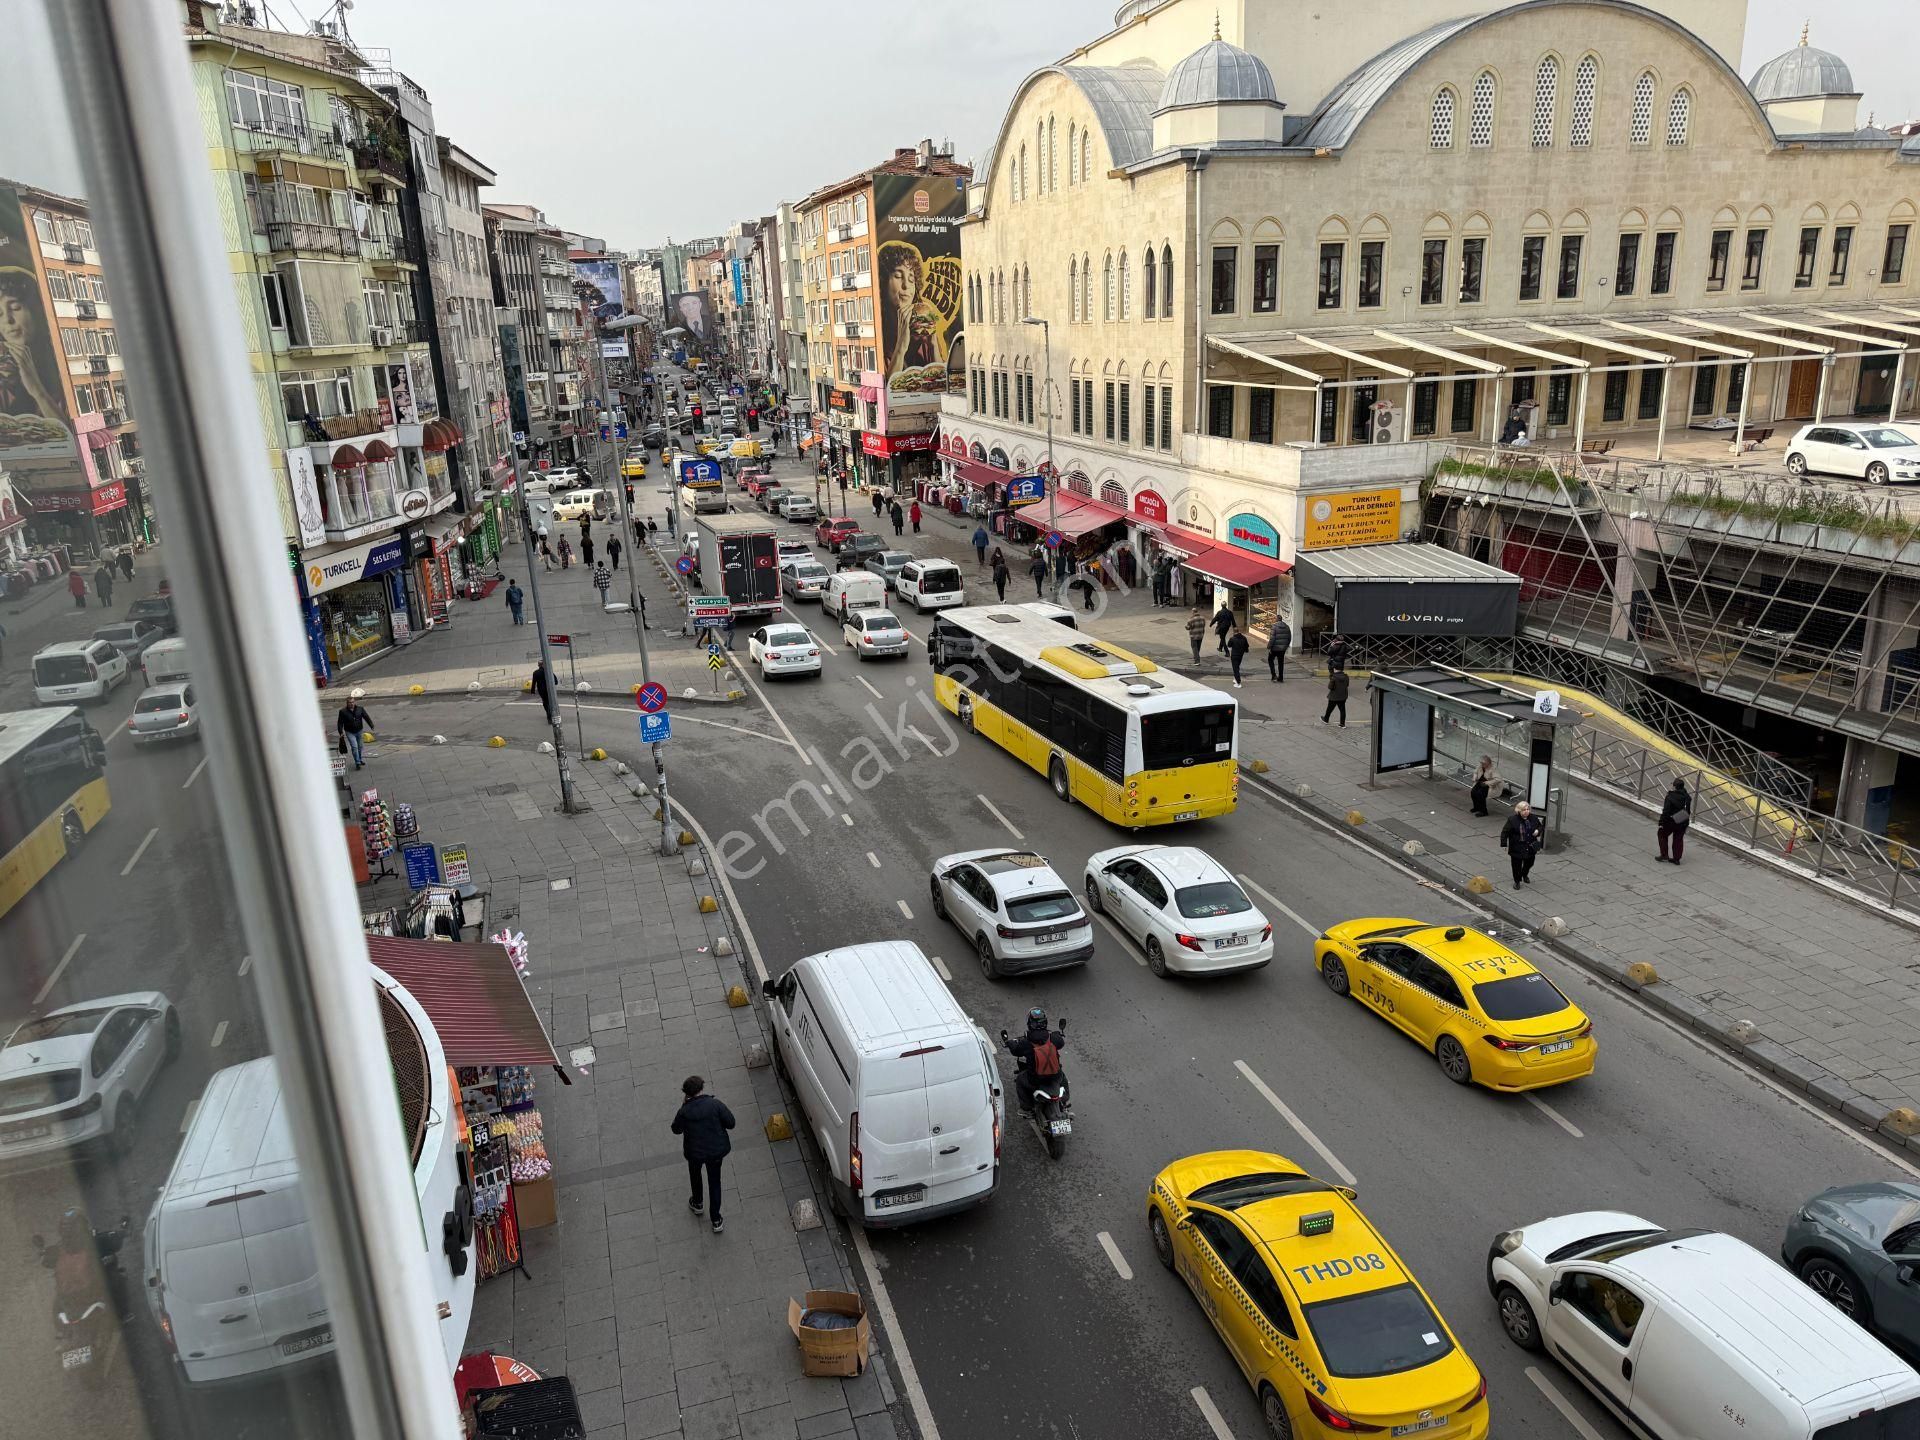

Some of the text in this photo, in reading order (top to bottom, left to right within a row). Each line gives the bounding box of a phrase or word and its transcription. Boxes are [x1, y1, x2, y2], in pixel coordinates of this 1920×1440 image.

[899, 224, 947, 235] 30 Yıldır Aynı
[929, 261, 961, 285] LEZZET
[925, 272, 960, 303] ALEV
[922, 283, 955, 320] ALDI
[1336, 501, 1396, 512] ANITLAR DERNEĞİ
[323, 557, 362, 579] TURKCELL
[1462, 955, 1519, 973] TFJ73
[1359, 979, 1396, 1014] TFJ73
[474, 1132, 489, 1147] 99
